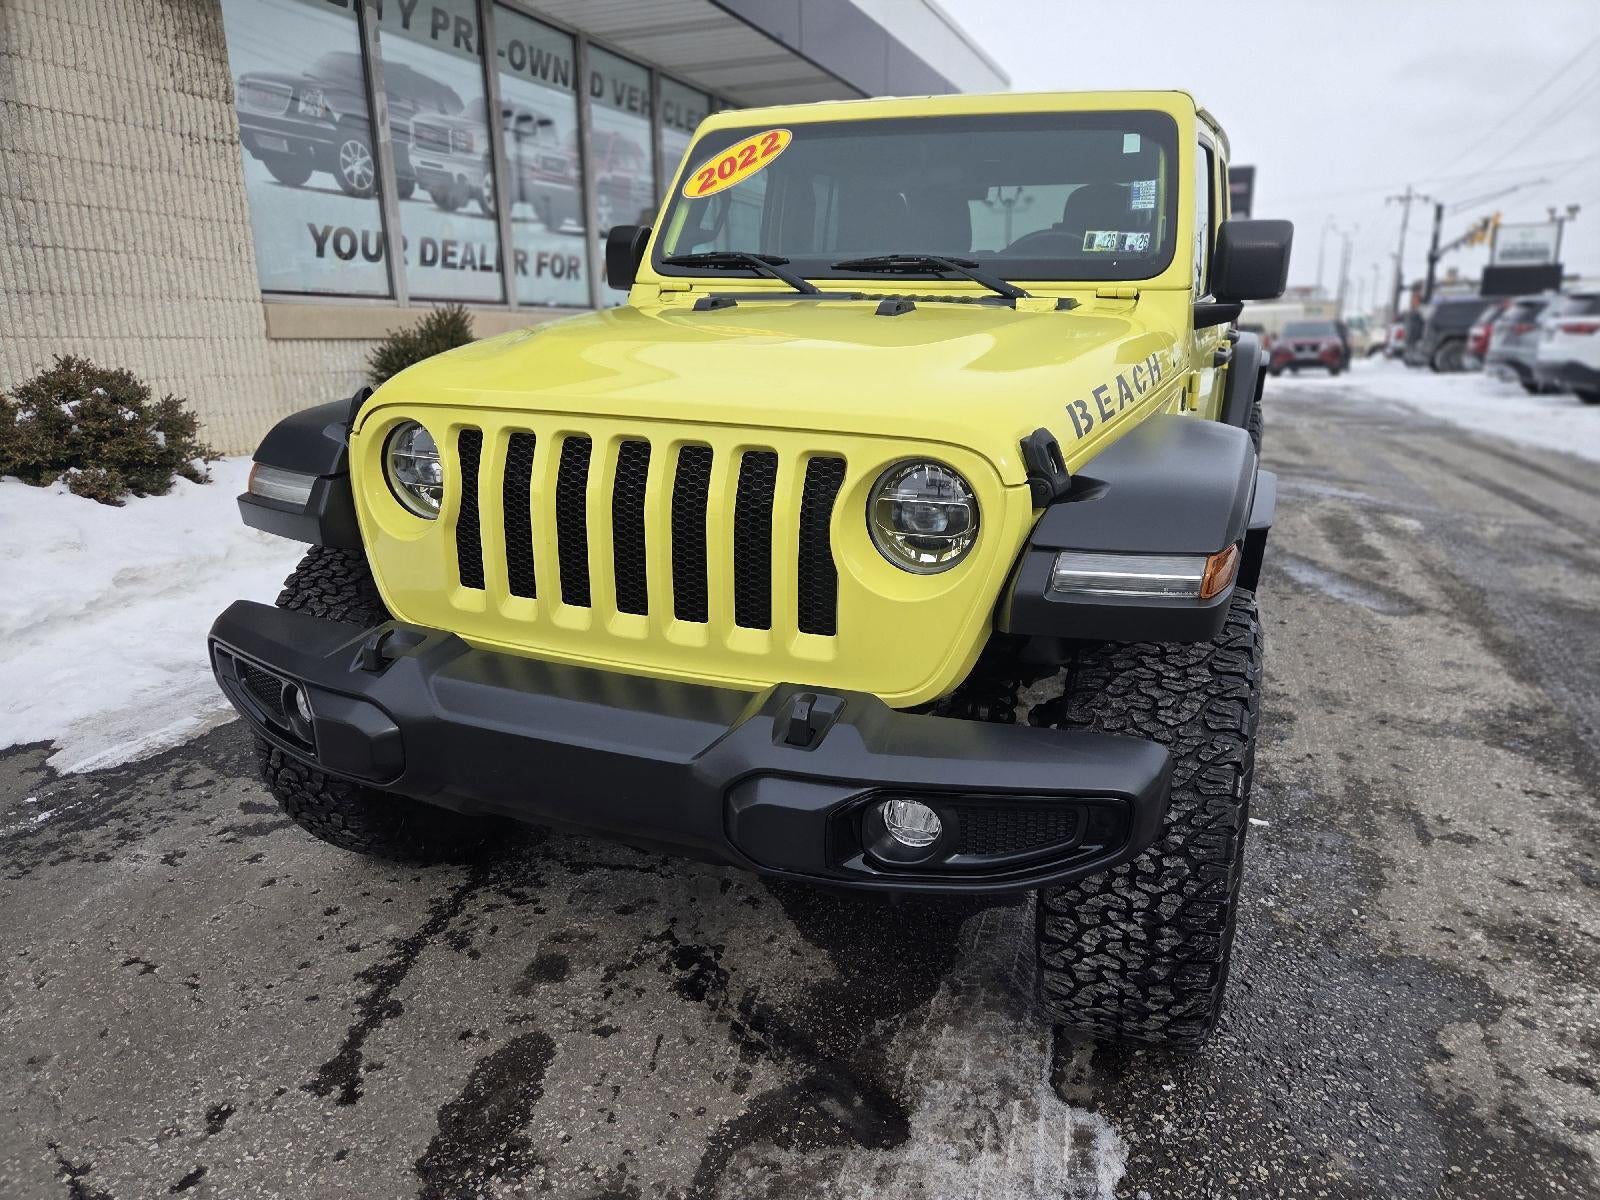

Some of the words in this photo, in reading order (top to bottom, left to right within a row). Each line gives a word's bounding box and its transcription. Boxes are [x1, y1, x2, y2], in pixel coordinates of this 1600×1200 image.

[431, 6, 604, 98] PR-OWND
[612, 78, 703, 131] VEHCLE
[697, 132, 781, 194] 2022
[419, 236, 529, 276] DEALR
[536, 251, 581, 281] FOR
[1065, 353, 1162, 440] BEACH
